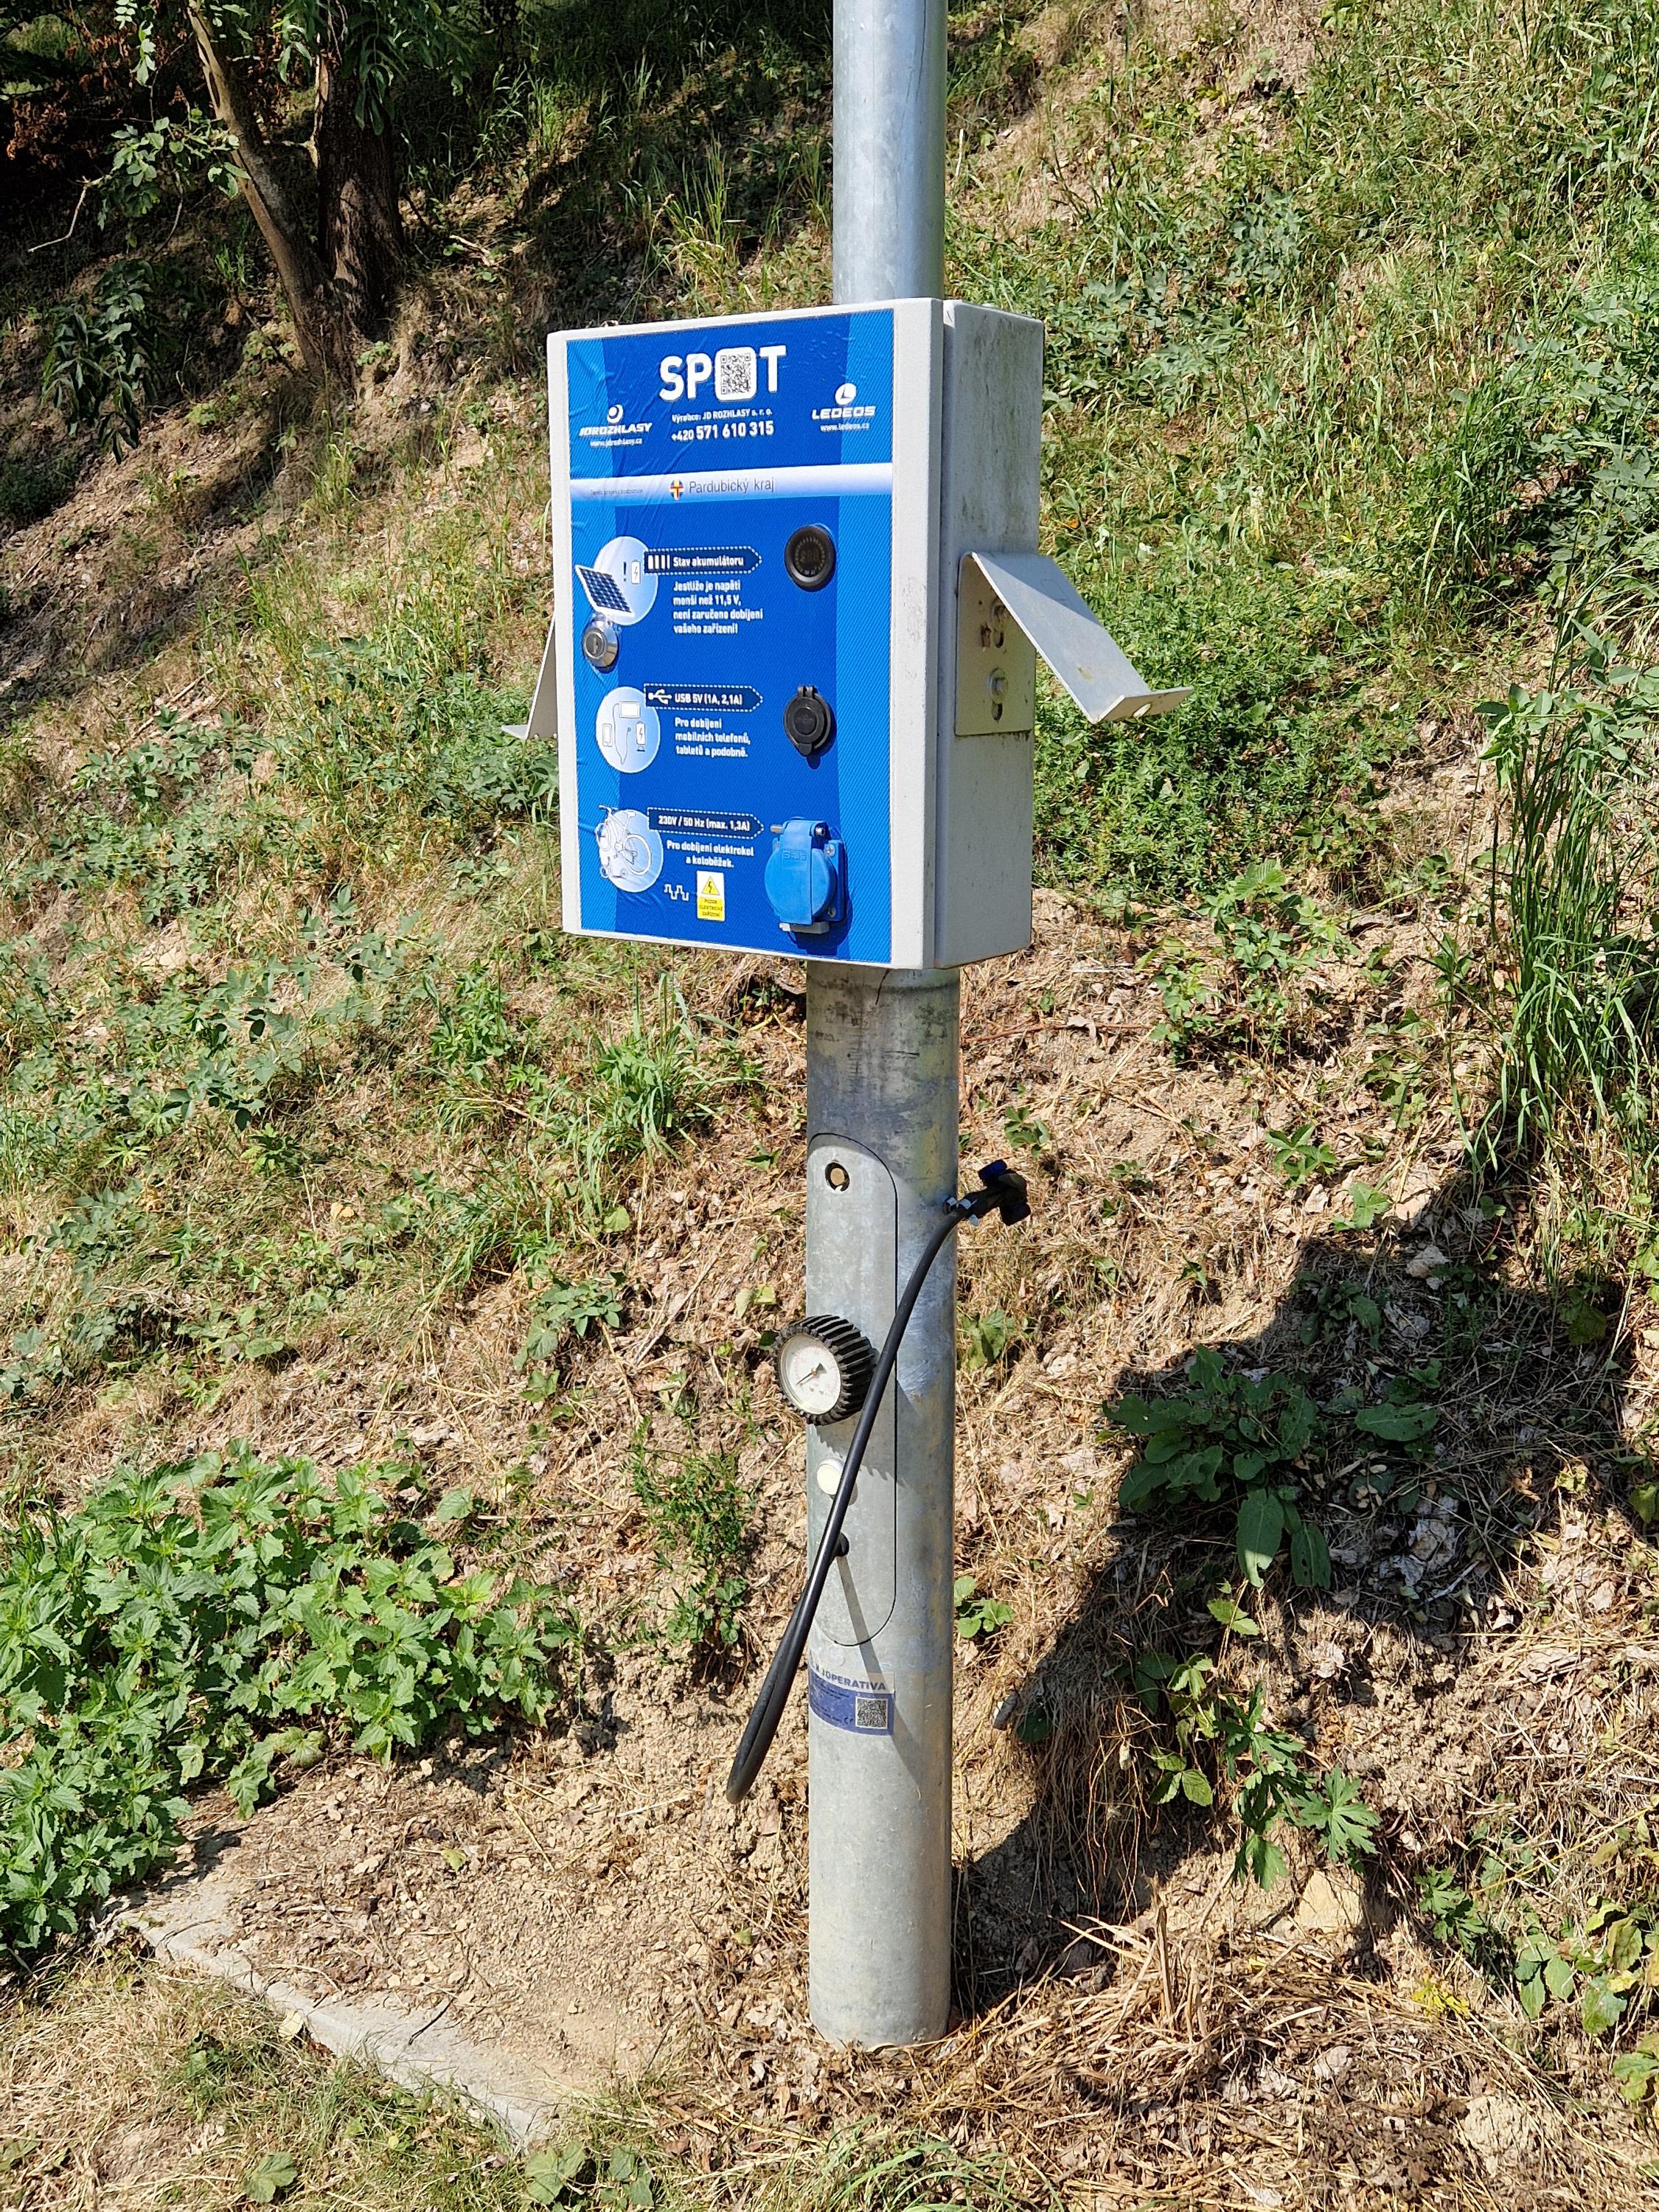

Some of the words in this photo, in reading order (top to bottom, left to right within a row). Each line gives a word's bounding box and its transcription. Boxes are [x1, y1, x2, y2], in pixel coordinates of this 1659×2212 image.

[659, 345, 787, 401] SPOT
[702, 411, 712, 420] JD
[712, 408, 750, 420] ROZHLASY
[812, 406, 876, 420] LEDEOS
[671, 429, 694, 441] +420
[696, 425, 718, 440] 571
[723, 422, 746, 438] 610
[749, 420, 773, 437] 315
[689, 478, 749, 495] Pardubický
[754, 476, 774, 493] kraj
[673, 557, 690, 567] Stav
[692, 555, 744, 566] akumulátoru
[673, 580, 704, 591] Jestliže
[705, 580, 713, 593] je
[714, 579, 740, 592] napětí
[673, 594, 697, 606] menší
[698, 594, 713, 605] než
[715, 594, 731, 606] 11,5
[733, 594, 741, 606] V,
[673, 608, 690, 619] není
[692, 608, 728, 619] zaručeno
[673, 622, 701, 634] vašeho
[703, 622, 738, 634] zařízení!
[675, 693, 691, 703] USB
[692, 693, 703, 703] 5V
[675, 717, 689, 728] Pro
[675, 731, 714, 742] mobilních
[714, 731, 751, 745] telefonů,
[675, 744, 703, 756] tabletů
[704, 748, 710, 756] a
[711, 747, 748, 758] podobně.
[658, 815, 677, 826] 230V
[684, 817, 693, 827] 50
[694, 818, 705, 827] Hz
[706, 818, 728, 830] (max.
[729, 820, 751, 832] 1,3A)
[667, 840, 681, 850] Pro
[713, 844, 754, 856] elektrokol
[686, 856, 692, 864] a
[692, 855, 734, 868] koloběžek.
